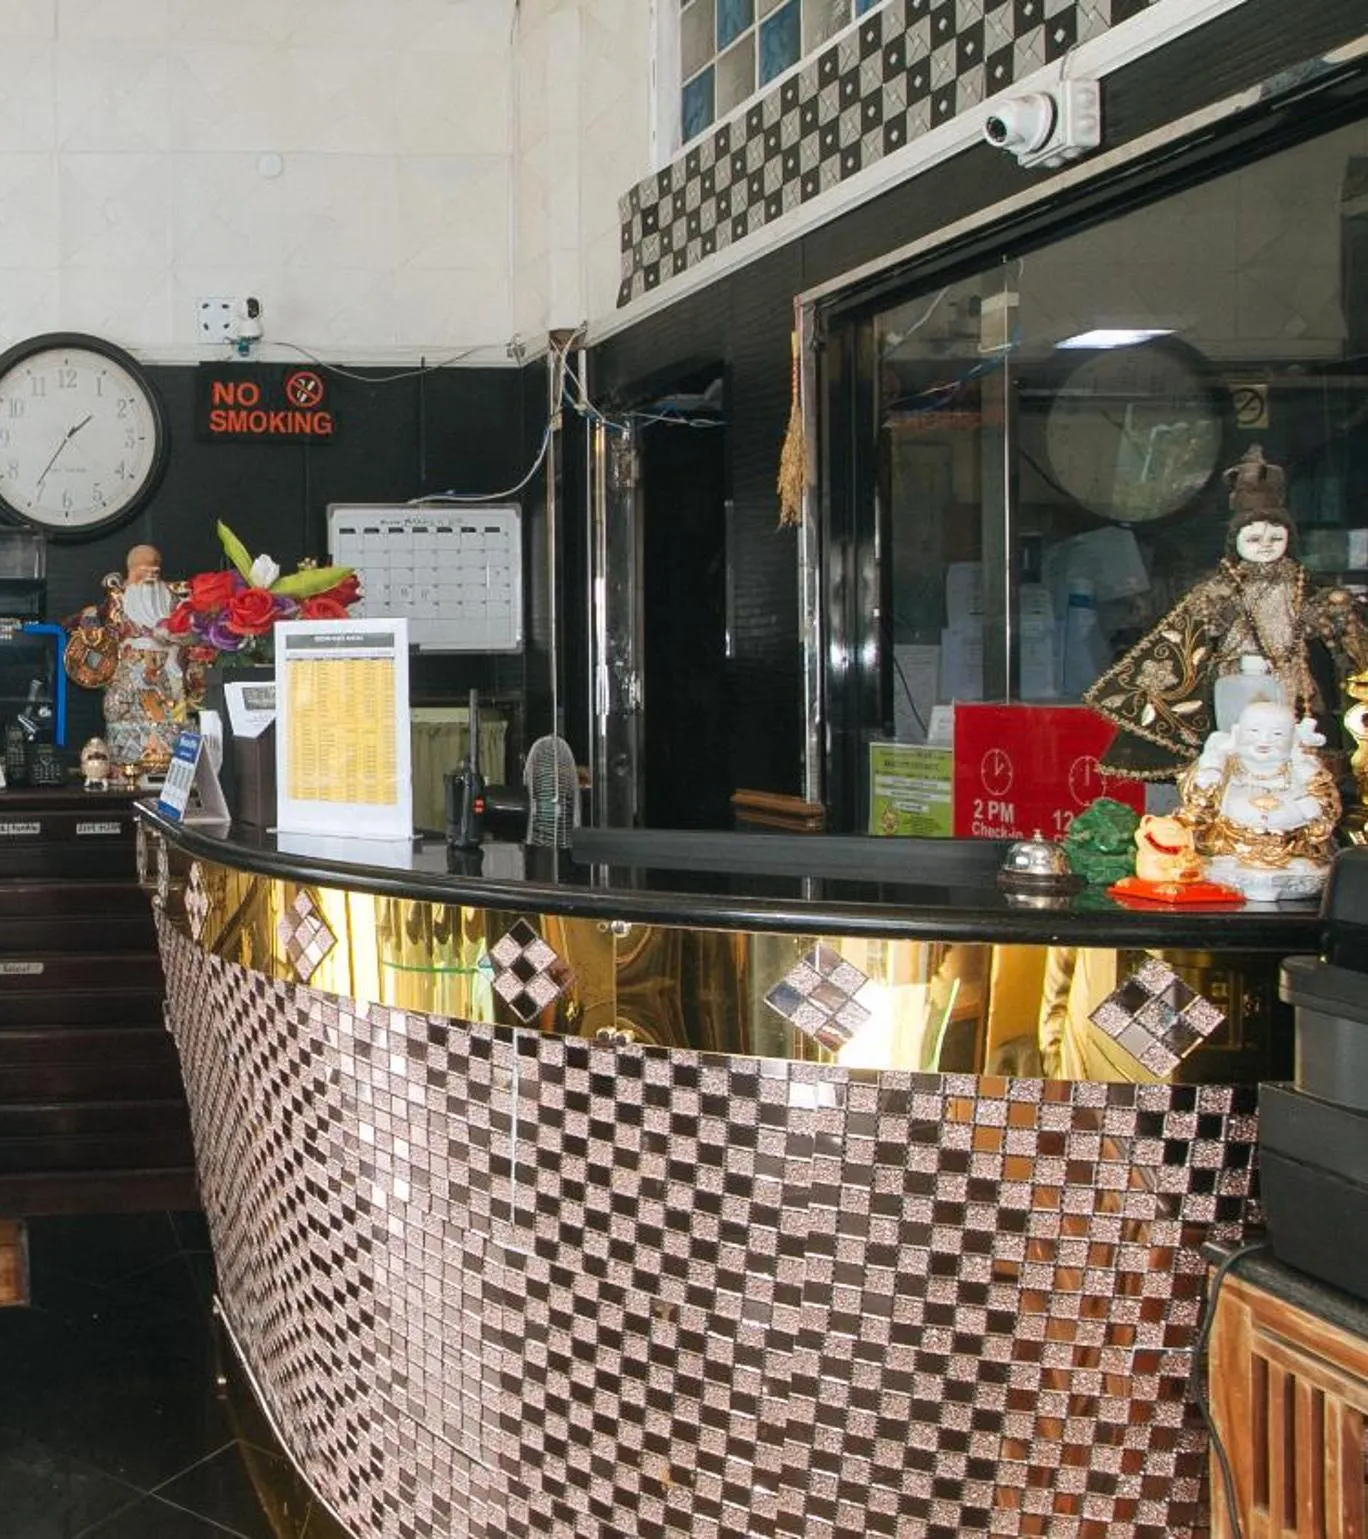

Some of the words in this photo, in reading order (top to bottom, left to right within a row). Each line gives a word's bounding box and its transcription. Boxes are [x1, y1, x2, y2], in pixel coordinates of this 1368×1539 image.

[32, 377, 46, 397] 11
[57, 369, 78, 389] 12
[96, 377, 103, 396] 1
[212, 381, 260, 406] NO
[9, 399, 23, 418] 10
[117, 401, 127, 418] 2
[209, 410, 332, 434] SMOKING
[0, 429, 9, 447] 9
[125, 427, 135, 448] 3
[8, 460, 18, 480] 8
[114, 460, 124, 480] 4
[62, 488, 73, 508] 6
[92, 482, 103, 501] 5
[973, 799, 984, 819] 2
[987, 801, 1015, 824] PM
[1053, 809, 1075, 832] 12
[972, 821, 1024, 841] Check-in
